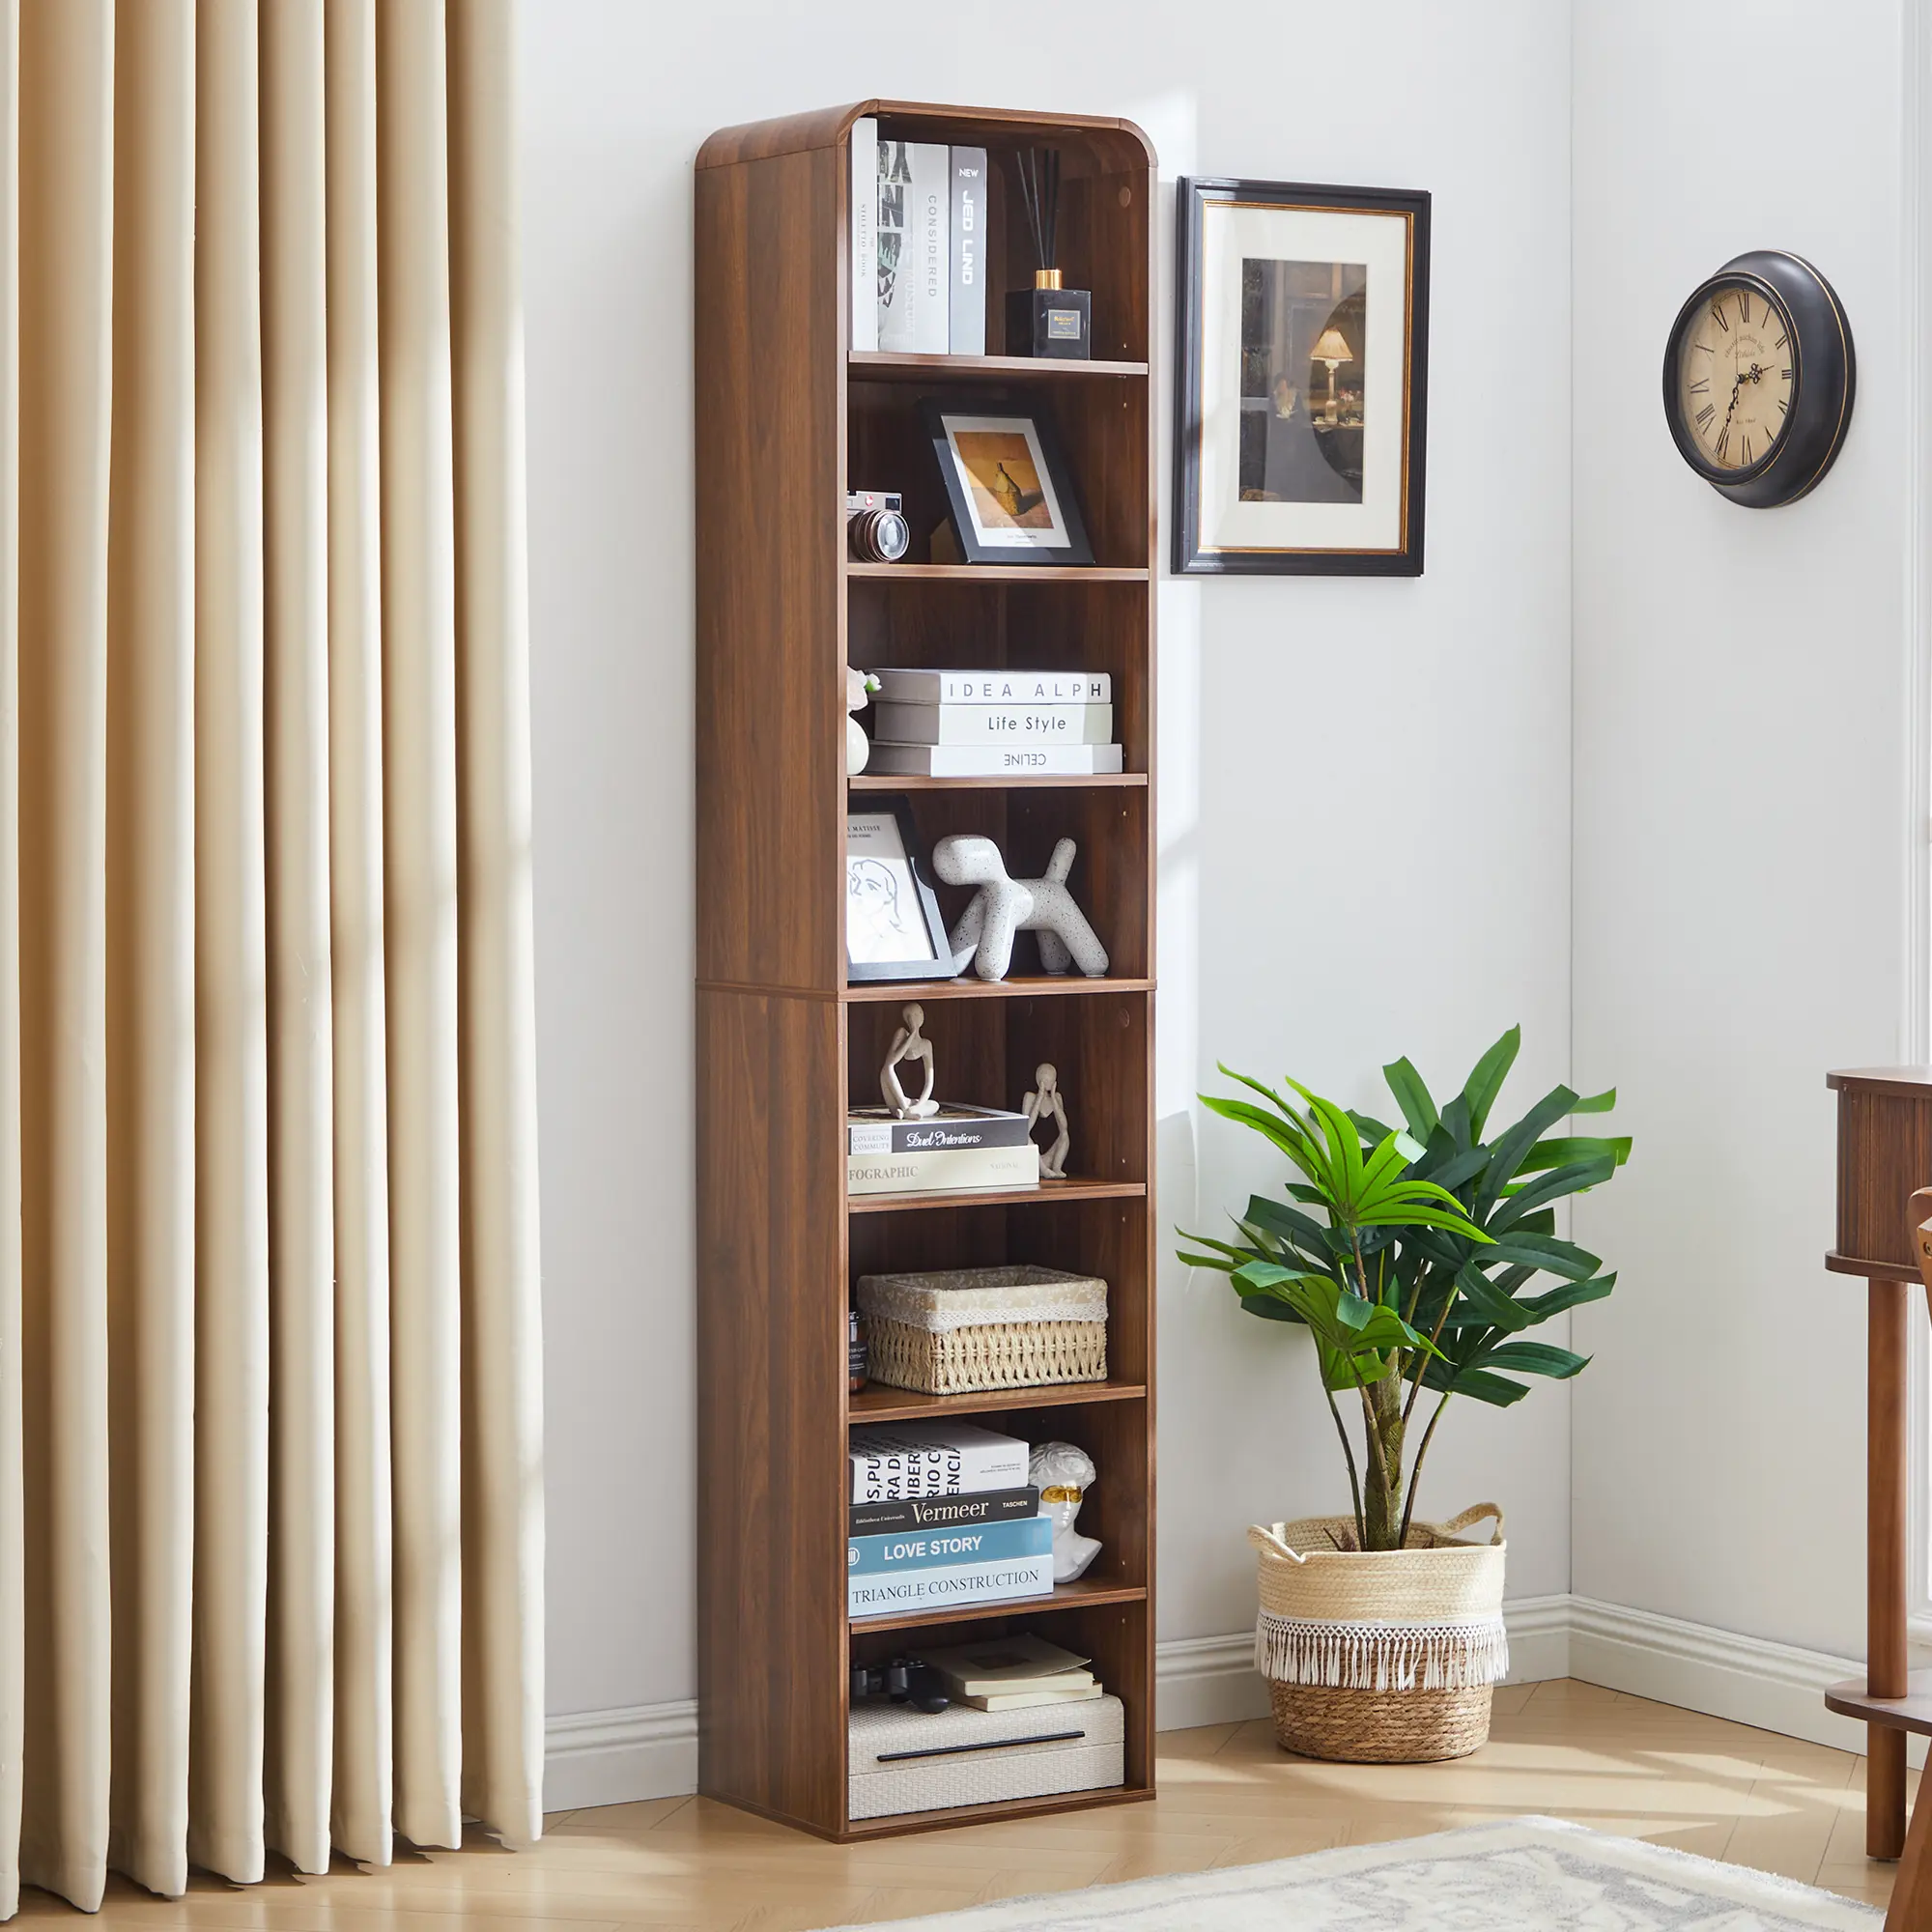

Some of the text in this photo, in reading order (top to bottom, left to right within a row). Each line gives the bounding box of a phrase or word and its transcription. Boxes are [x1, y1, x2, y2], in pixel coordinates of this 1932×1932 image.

[958, 168, 979, 178] NEW
[927, 194, 937, 297] CONSIDERED
[962, 189, 975, 285] JED LIND
[950, 683, 1101, 696] IDEA ALPH
[988, 716, 1066, 733] Life Style
[1004, 753, 1047, 766] CELINE
[911, 1501, 989, 1524] Vermeer
[1003, 1500, 1028, 1509] TASCHEN
[884, 1535, 983, 1561] LOVE STORY
[852, 1569, 1039, 1605] TRIANGLE CONSTRUCTION
